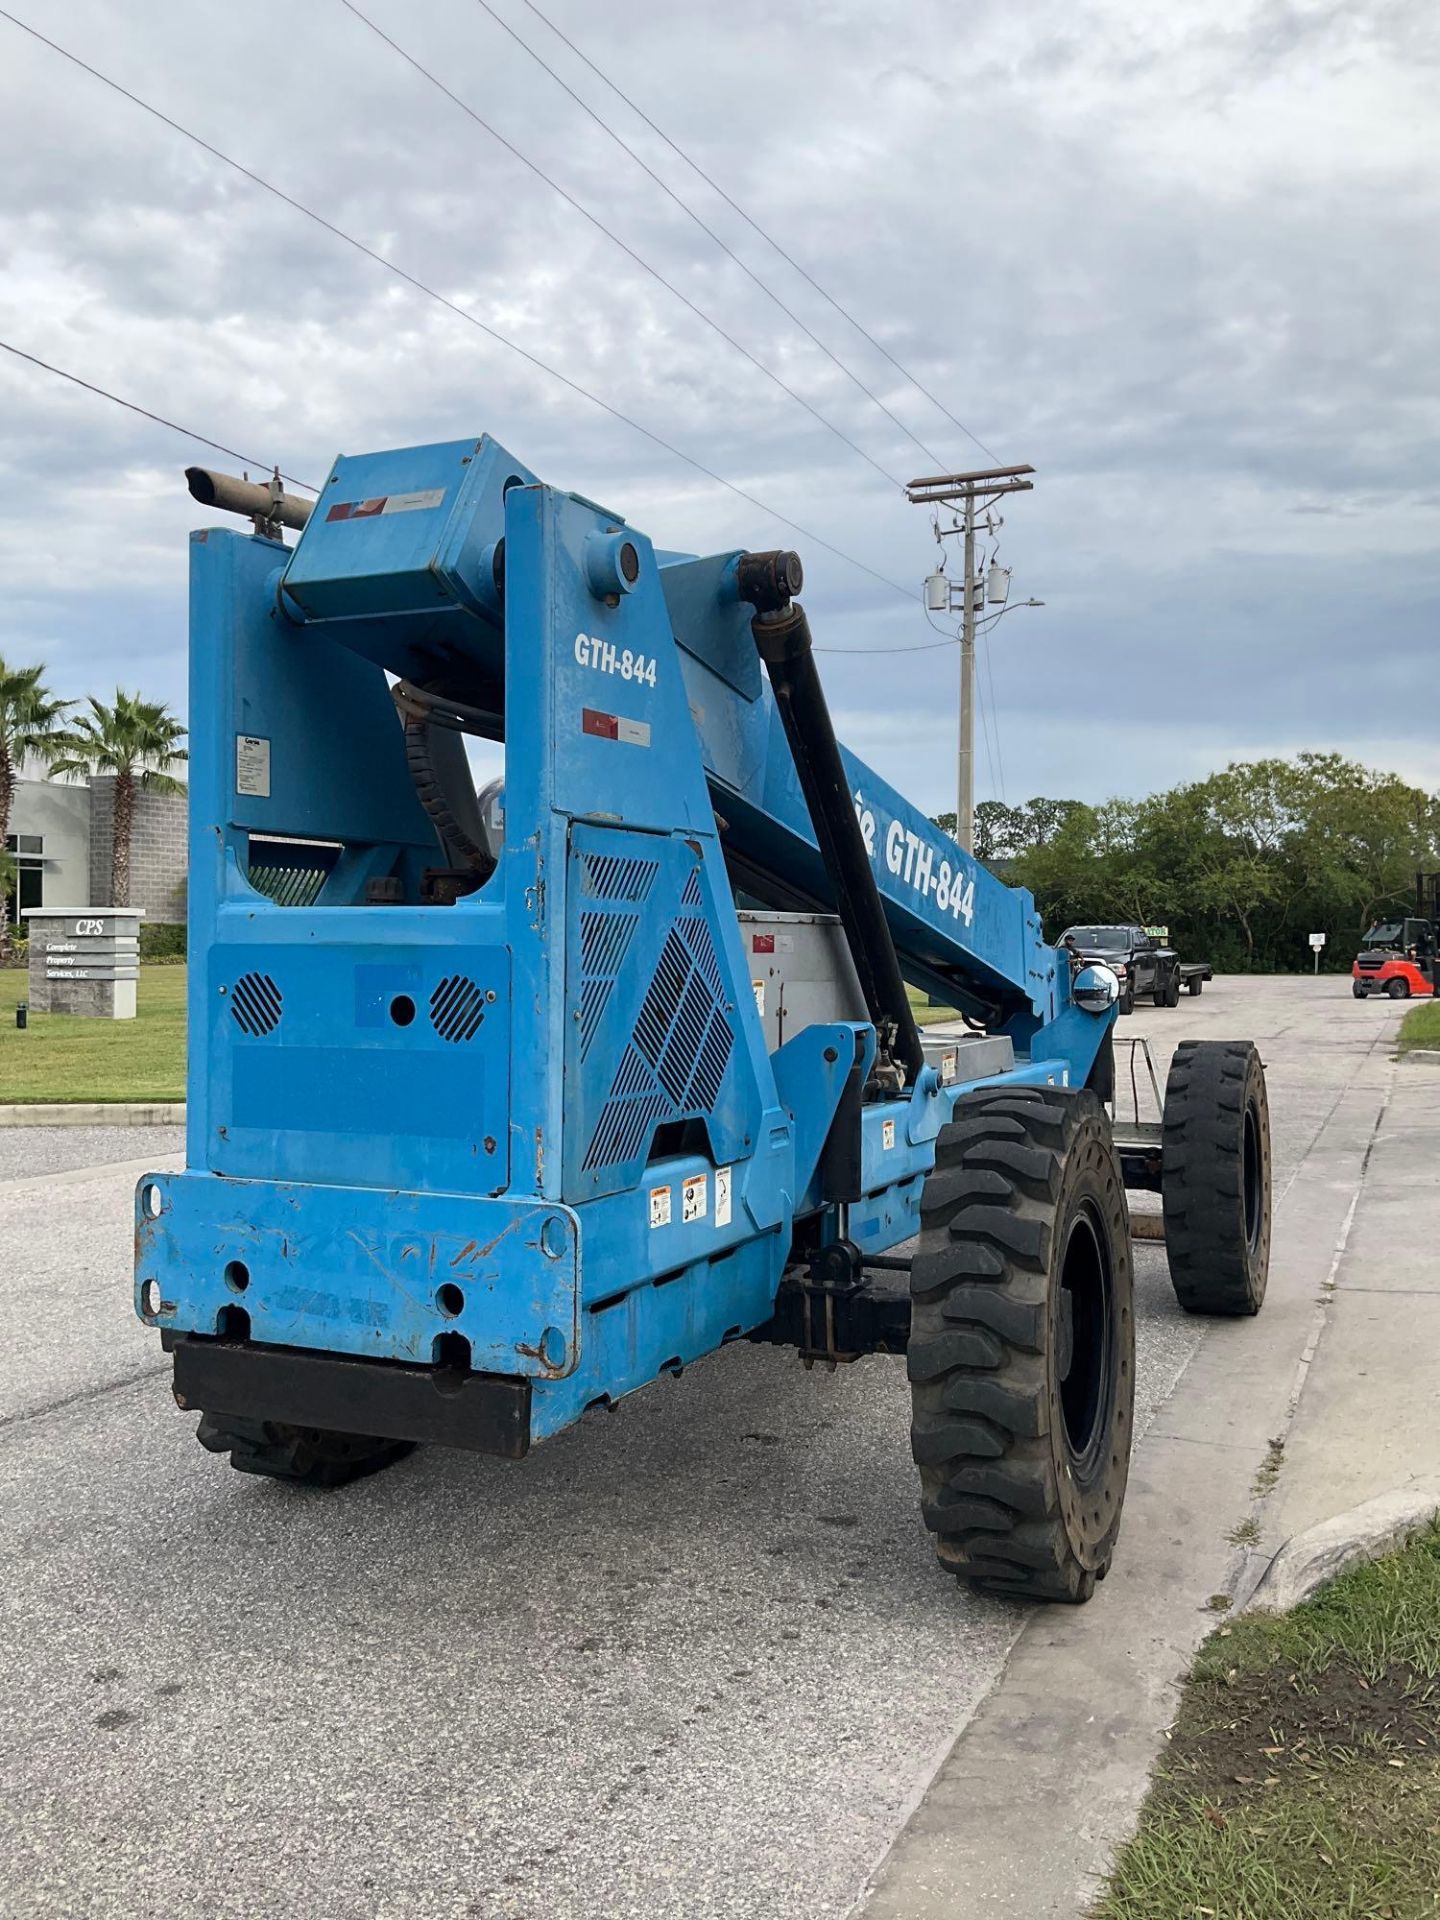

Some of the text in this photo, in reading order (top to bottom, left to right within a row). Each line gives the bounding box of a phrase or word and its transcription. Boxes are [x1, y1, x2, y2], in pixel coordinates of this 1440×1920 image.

[574, 633, 656, 688] GTH-844
[886, 819, 975, 928] GTH-844
[75, 919, 104, 935] CPS
[46, 943, 77, 952] Complete
[46, 956, 75, 966] Property
[46, 969, 89, 978] Services, LLC
